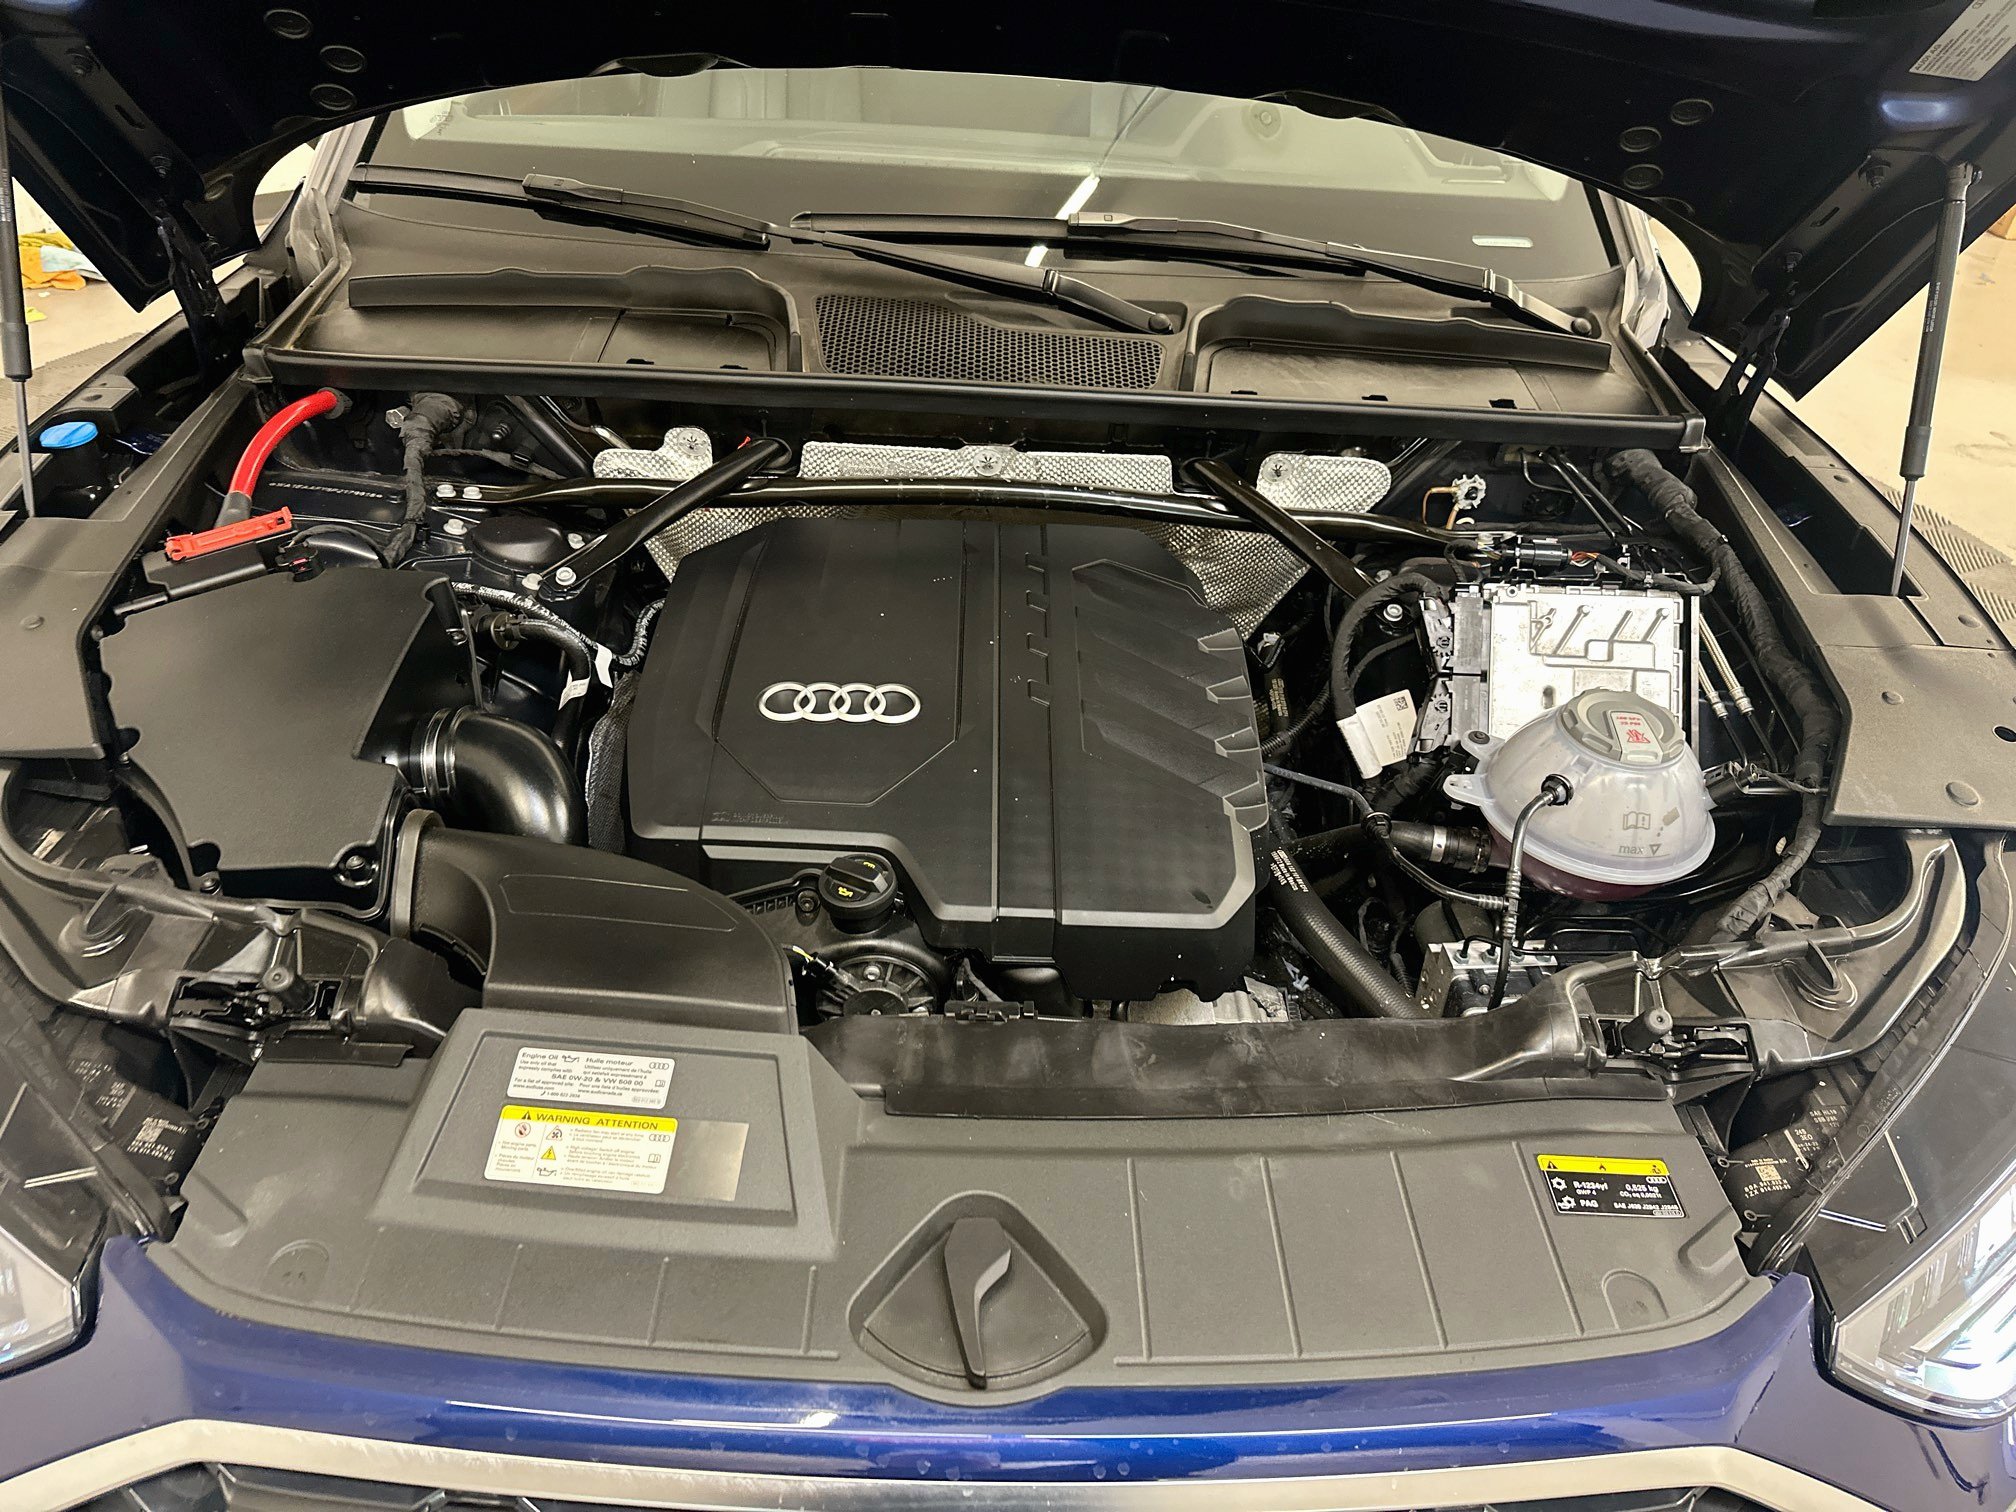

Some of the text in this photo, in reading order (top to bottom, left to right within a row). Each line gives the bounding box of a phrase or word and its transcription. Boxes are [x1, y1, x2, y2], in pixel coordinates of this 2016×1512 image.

[1618, 845, 1643, 855] max
[522, 1052, 546, 1060] Engine
[536, 1113, 658, 1130] WARNING ATTENTION
[1573, 1181, 1608, 1191] R-1234yf
[1648, 1185, 1659, 1193] kg
[1579, 1199, 1598, 1208] PAG
